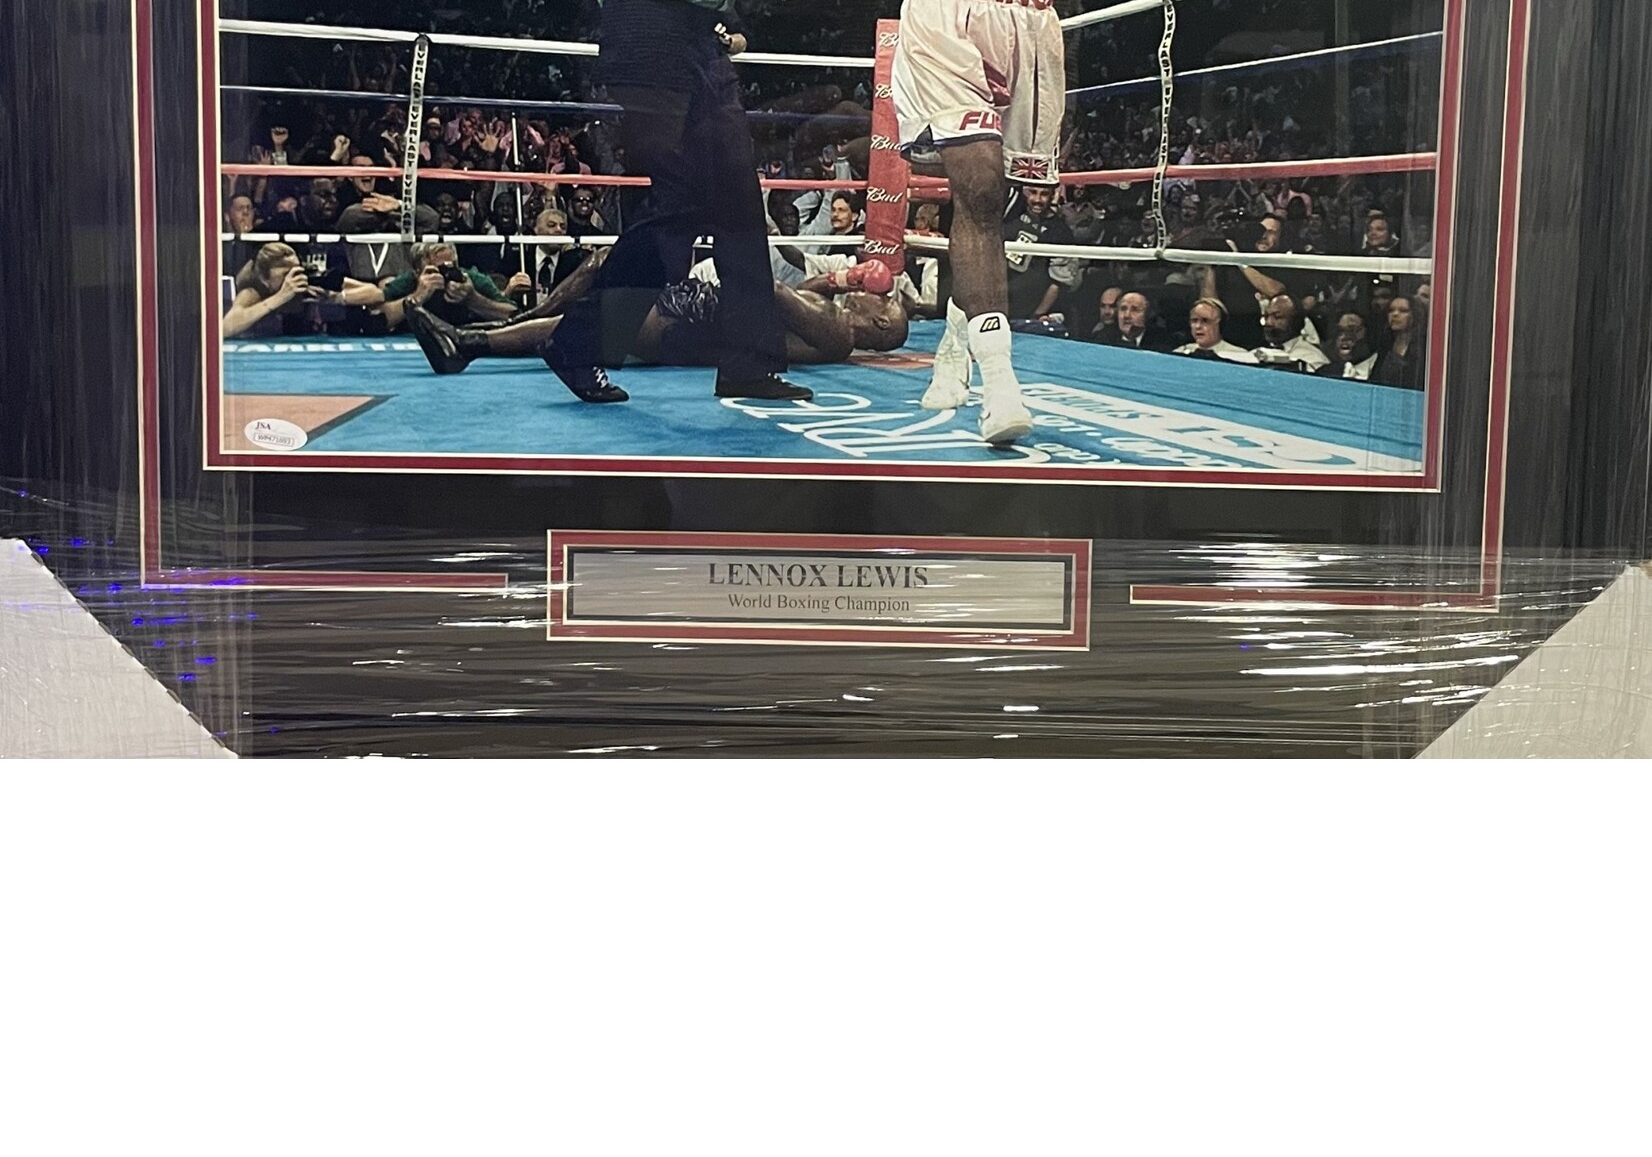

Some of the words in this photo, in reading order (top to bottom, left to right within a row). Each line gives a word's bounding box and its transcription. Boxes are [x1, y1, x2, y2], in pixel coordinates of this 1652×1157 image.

[1160, 4, 1175, 77] EVERLAST
[406, 105, 420, 168] EVERLAST
[866, 186, 904, 203] Bud
[863, 239, 900, 255] Bud
[255, 421, 272, 430] JSA
[708, 562, 828, 588] LENNOX
[837, 564, 929, 589] LEWIS
[728, 593, 772, 609] World
[777, 594, 831, 613] Boxing
[834, 595, 911, 615] Champion
